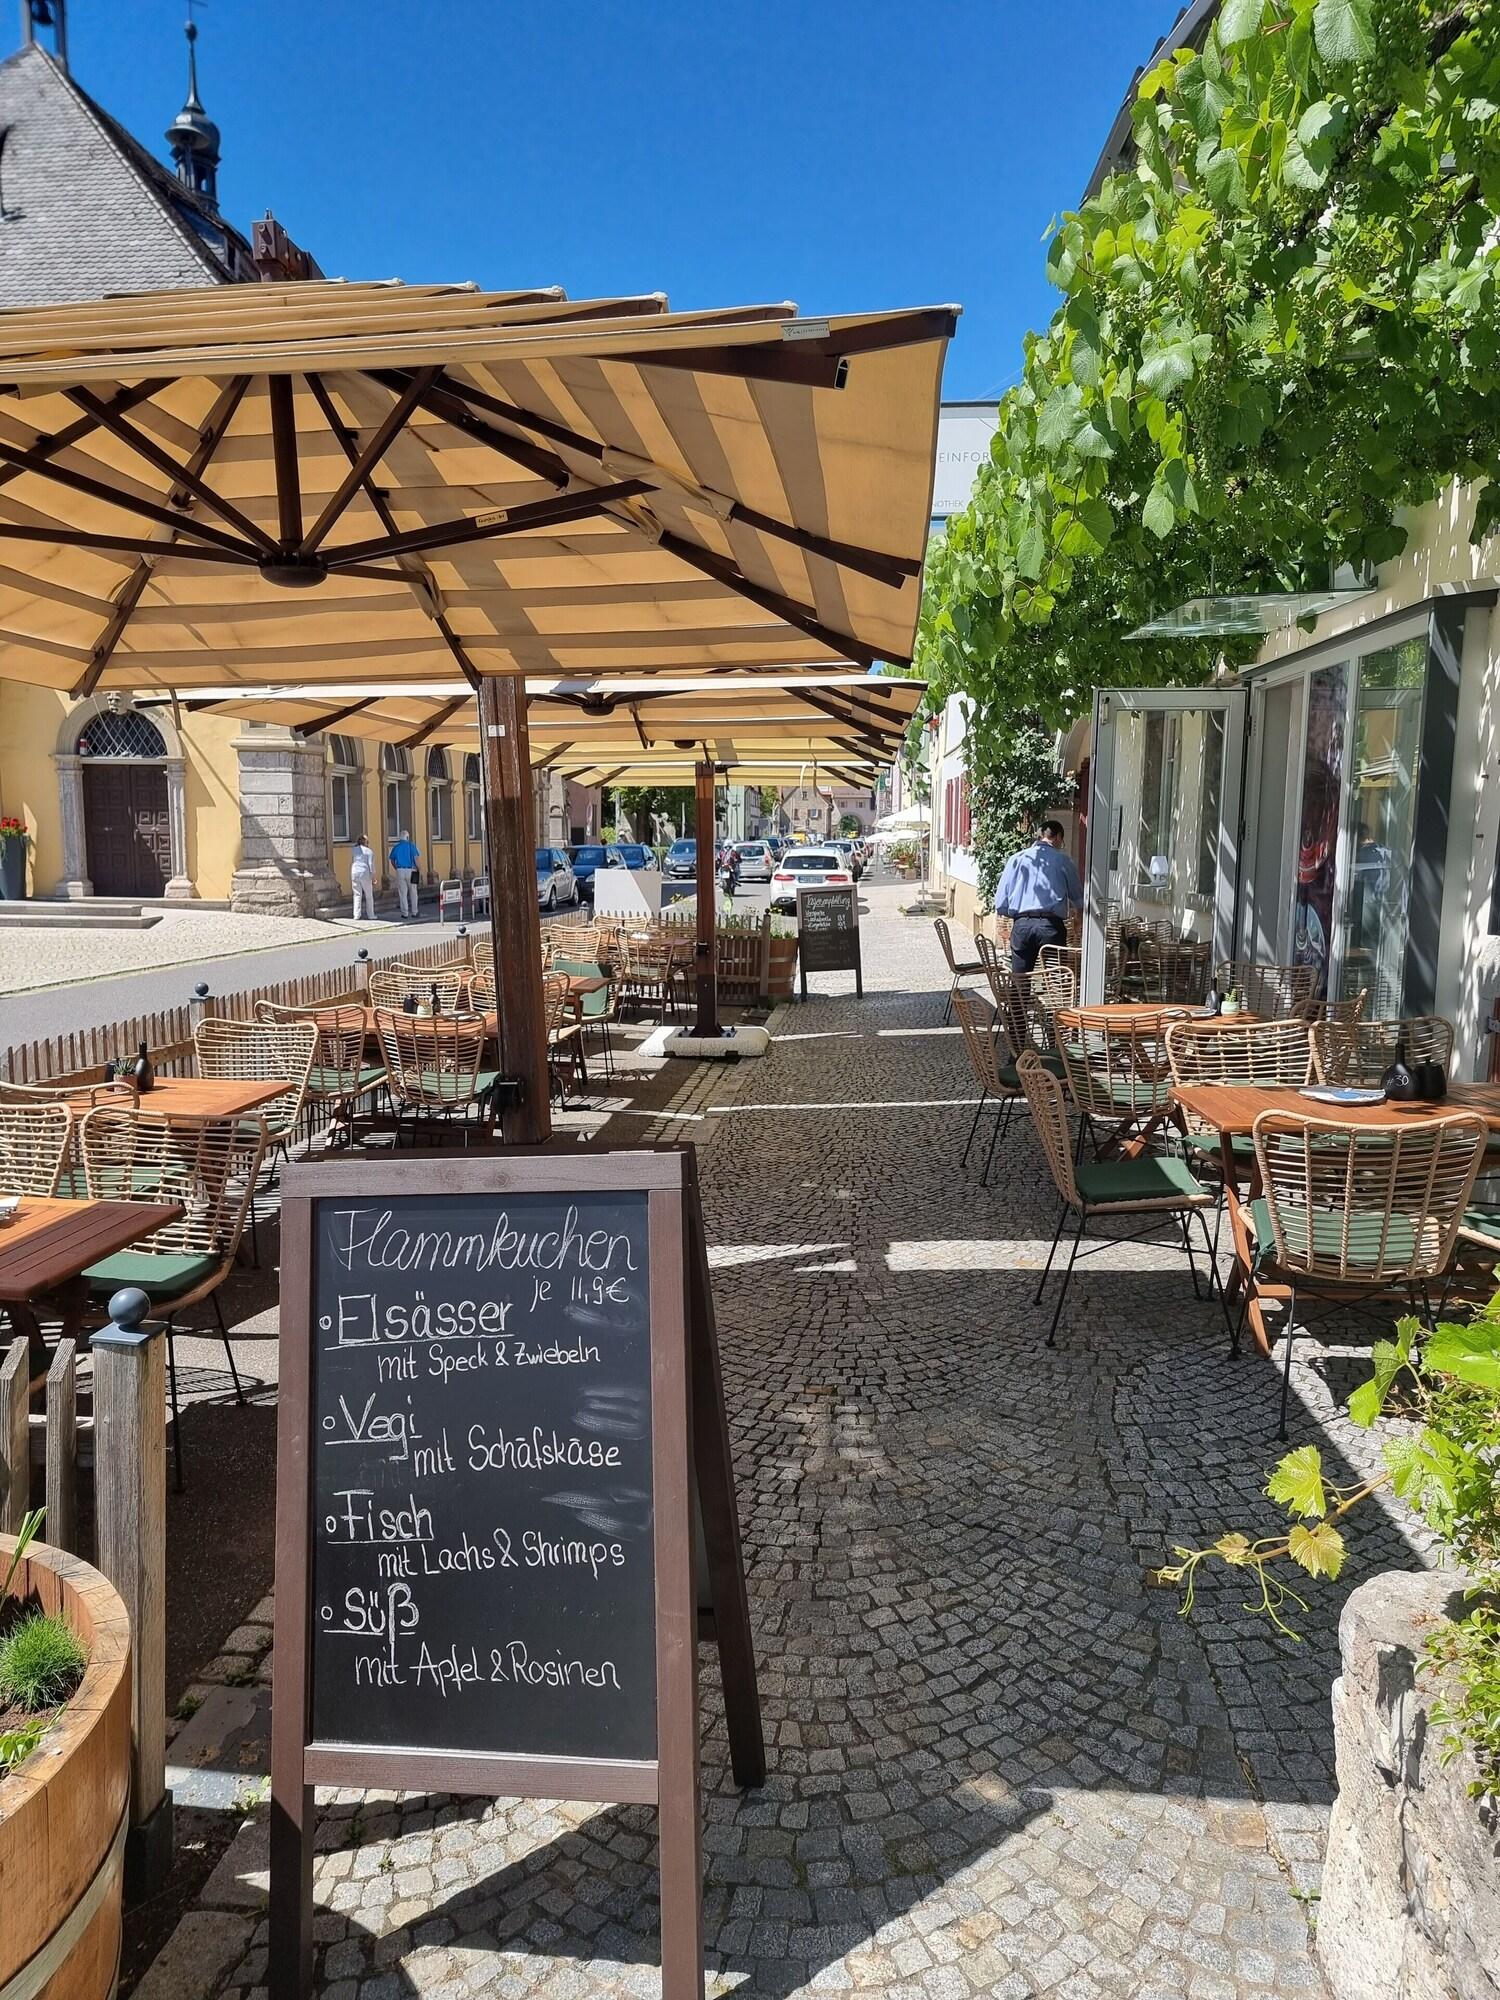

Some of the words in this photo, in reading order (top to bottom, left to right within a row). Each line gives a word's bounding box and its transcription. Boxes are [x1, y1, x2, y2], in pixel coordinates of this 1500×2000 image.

[1386, 1074, 1409, 1087] #30
[333, 1204, 638, 1272] Flammkuchen
[337, 1290, 514, 1345] Elsässer
[530, 1275, 552, 1313] je
[377, 1352, 418, 1383] mit
[428, 1344, 489, 1384] Speck
[495, 1341, 510, 1367] &
[514, 1336, 602, 1366] Zwiebeln
[338, 1392, 419, 1461] Vegi
[413, 1428, 456, 1478] mit
[333, 1489, 435, 1542] Fisch
[378, 1546, 418, 1579] mit
[421, 1531, 496, 1575] Lachs
[493, 1527, 519, 1568] &
[522, 1530, 626, 1580] Shrimps
[343, 1582, 420, 1646] Süß
[355, 1645, 407, 1689] mit
[409, 1641, 484, 1699] Apfel
[490, 1648, 510, 1684] &
[506, 1640, 622, 1691] Rosinen
